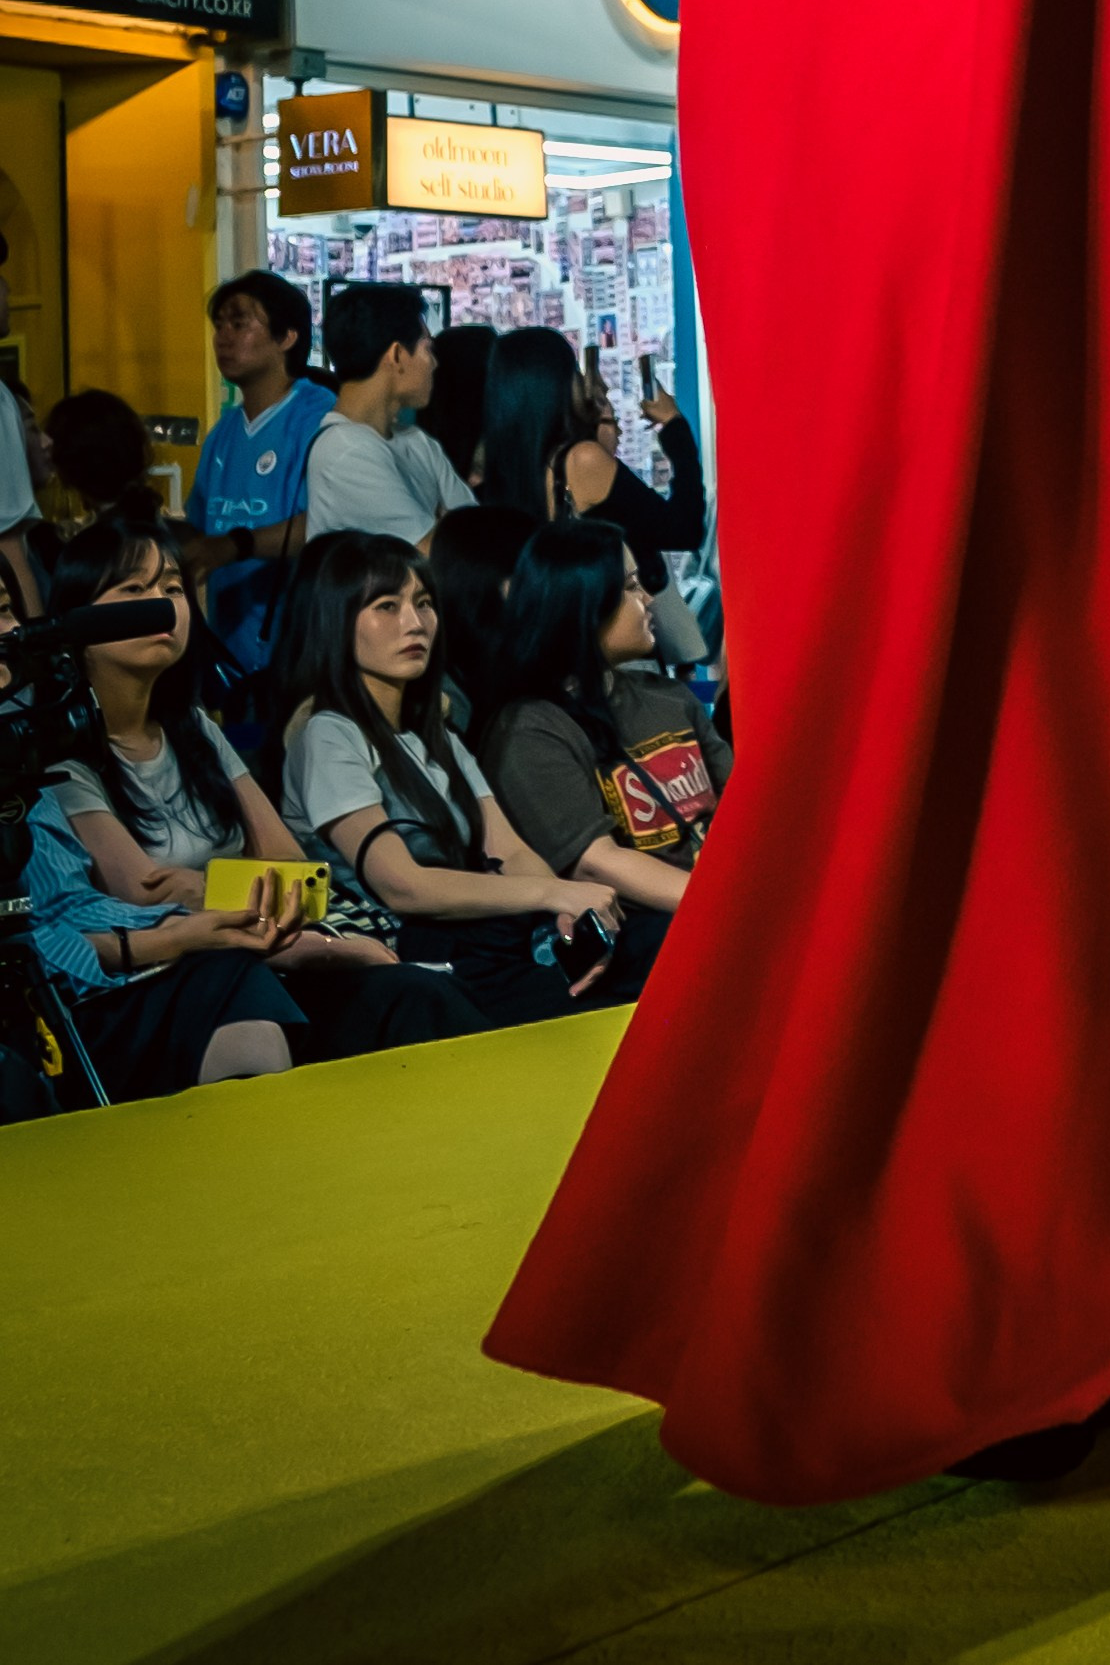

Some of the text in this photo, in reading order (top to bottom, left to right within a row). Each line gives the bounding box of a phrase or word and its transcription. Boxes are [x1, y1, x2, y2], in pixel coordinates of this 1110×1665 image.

[290, 128, 358, 160] VERA
[422, 136, 508, 167] oldmoon
[458, 177, 515, 202] studio
